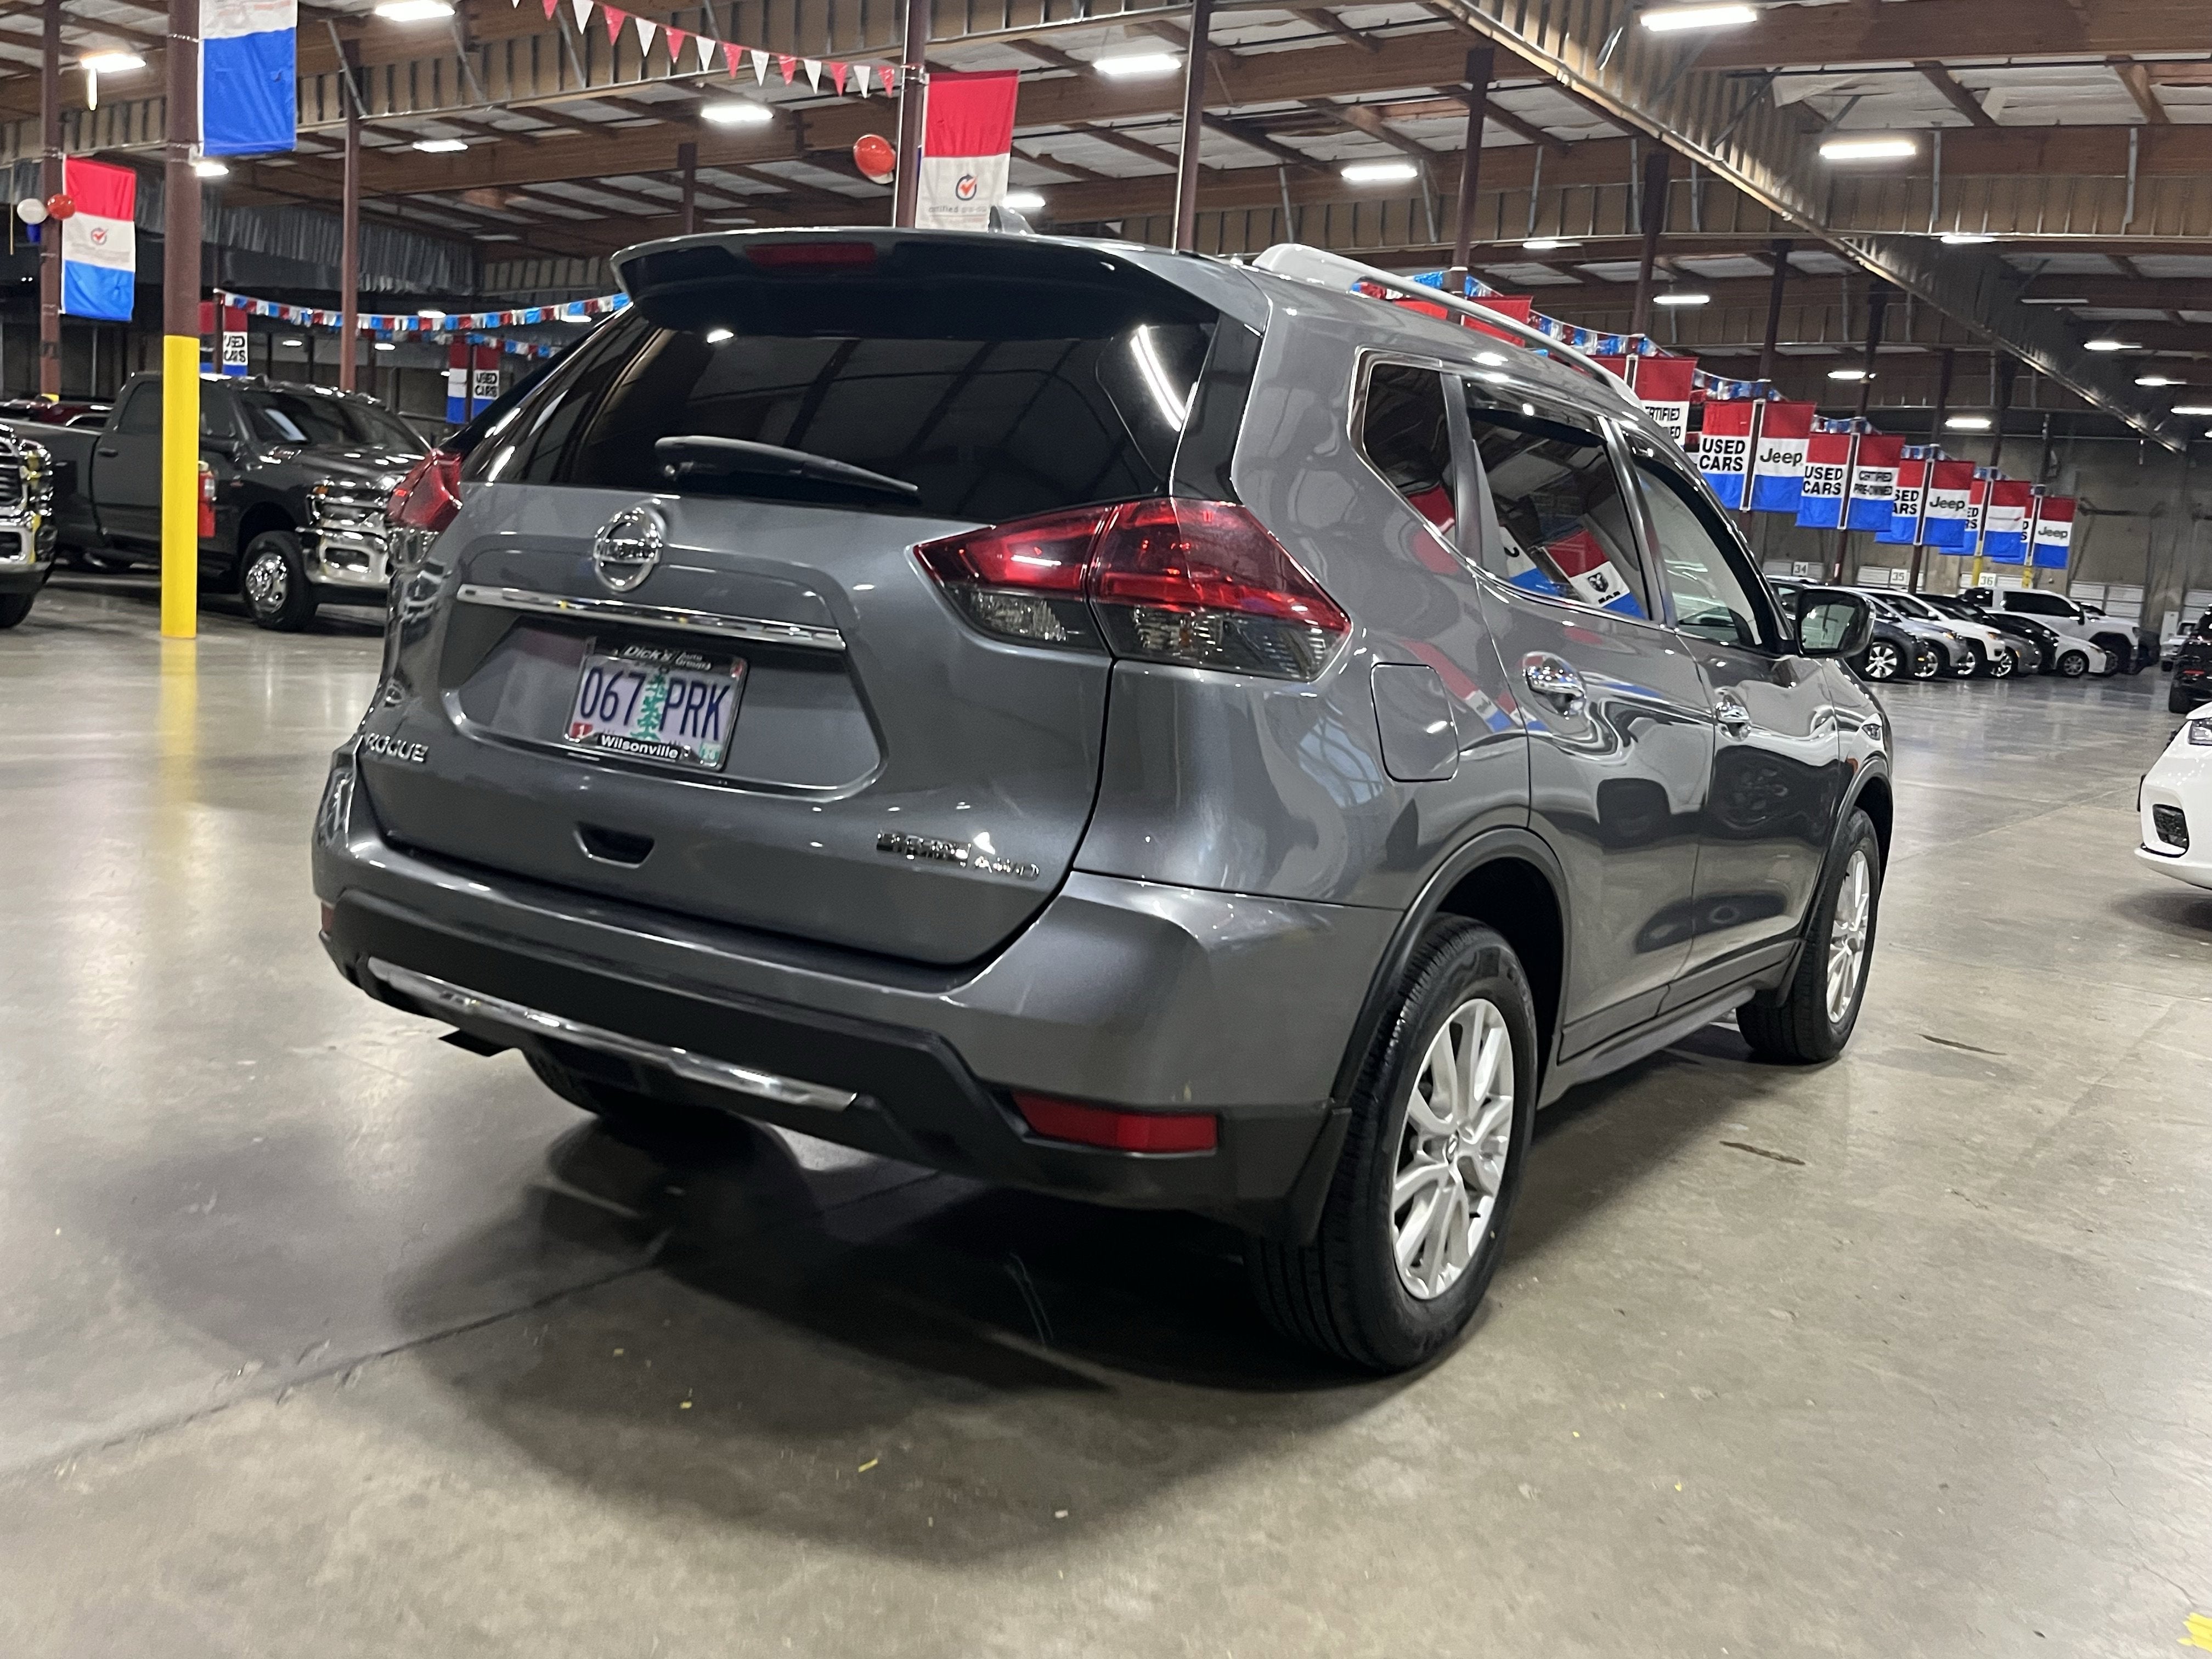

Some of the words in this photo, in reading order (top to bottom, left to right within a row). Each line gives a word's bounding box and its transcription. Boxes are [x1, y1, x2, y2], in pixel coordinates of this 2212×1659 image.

[1702, 438, 1746, 455] USED
[1699, 455, 1743, 472] CARS
[1759, 448, 1803, 466] Jeep
[1804, 466, 1843, 481] USED
[1803, 481, 1842, 495] CARS
[1894, 489, 1920, 502] SED
[1893, 503, 1918, 515] ARS
[1929, 496, 1966, 511] Jeep
[2038, 526, 2068, 540] Jeep
[1793, 564, 1807, 573] 34
[1893, 572, 1904, 581] 35
[1980, 576, 1994, 586] 36
[579, 666, 647, 726] 067
[658, 676, 732, 741] PRK
[365, 732, 429, 763] ROGUE
[601, 735, 679, 759] Wilsonville
